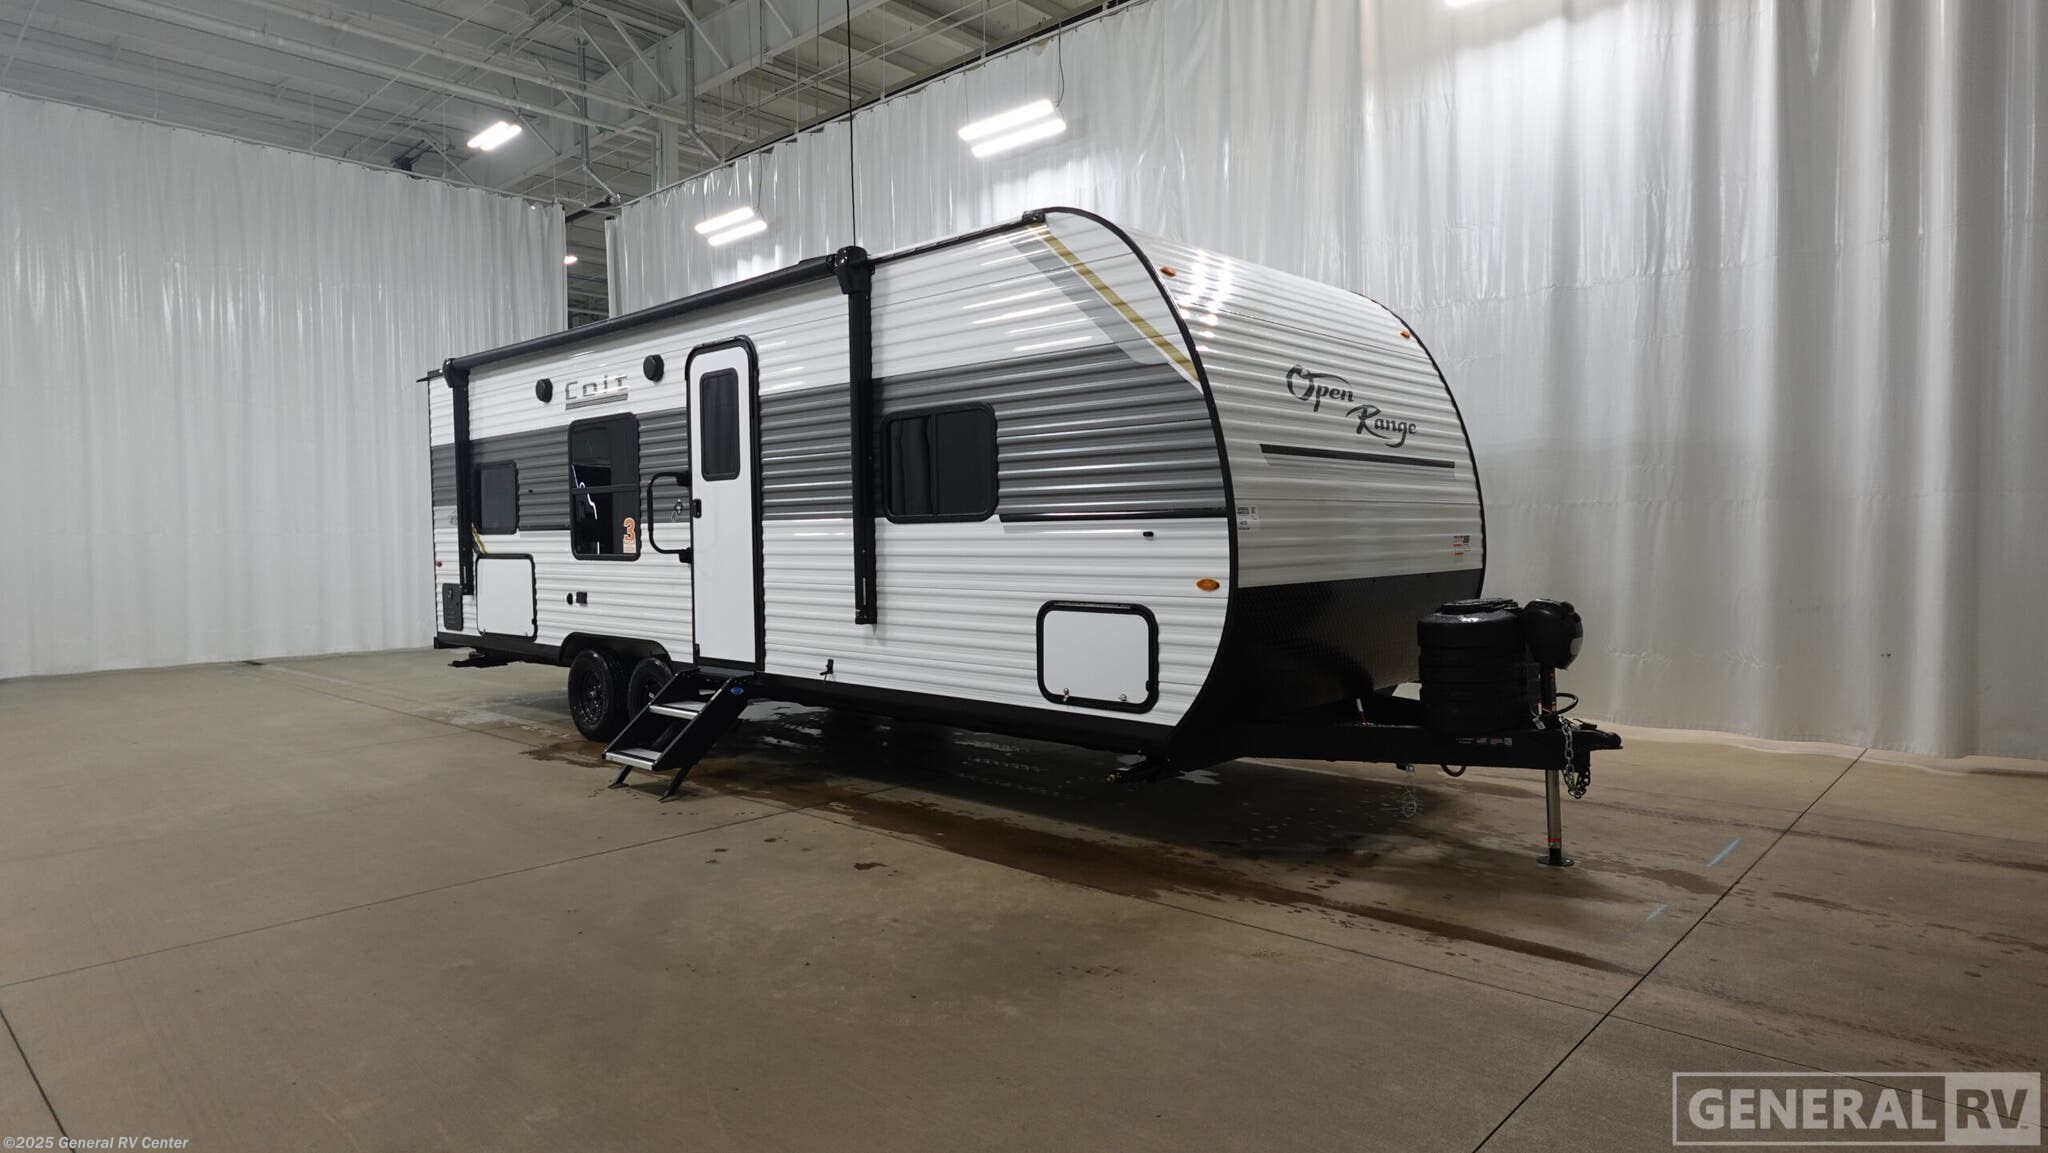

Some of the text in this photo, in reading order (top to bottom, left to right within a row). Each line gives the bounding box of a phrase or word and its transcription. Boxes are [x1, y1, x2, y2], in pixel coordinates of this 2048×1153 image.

[1286, 364, 1354, 412] Open
[1345, 404, 1416, 448] Range
[623, 517, 636, 541] 3
